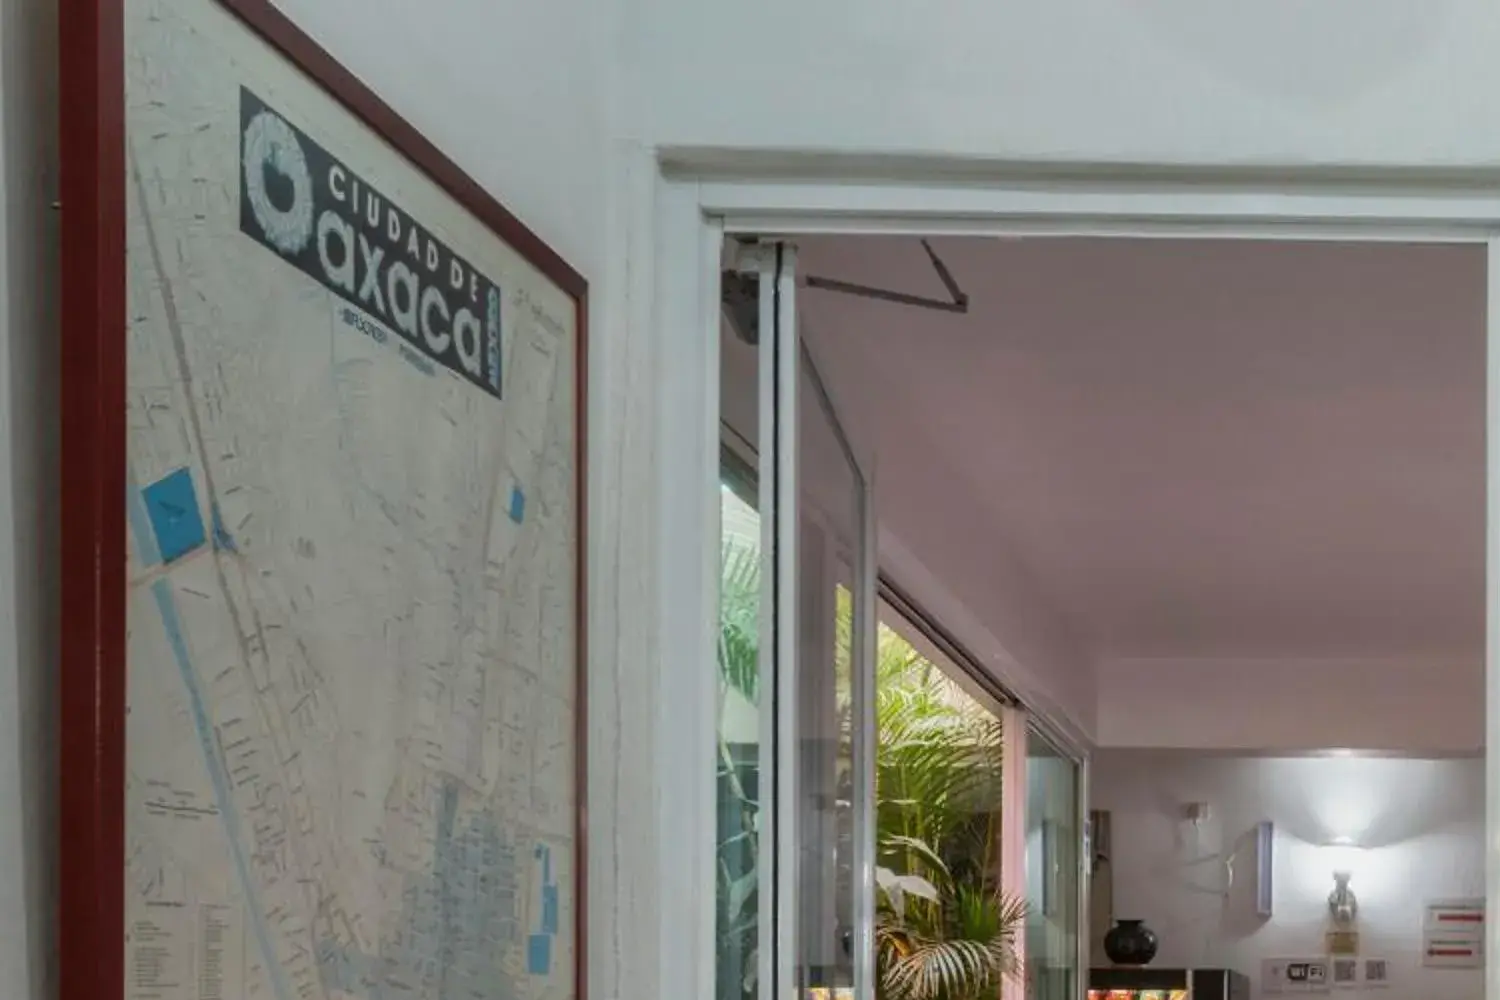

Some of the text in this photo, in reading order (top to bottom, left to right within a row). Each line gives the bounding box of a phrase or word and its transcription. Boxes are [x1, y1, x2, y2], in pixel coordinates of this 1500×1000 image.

[243, 110, 482, 378] Oaxaca
[329, 164, 479, 302] CIUDAD DE
